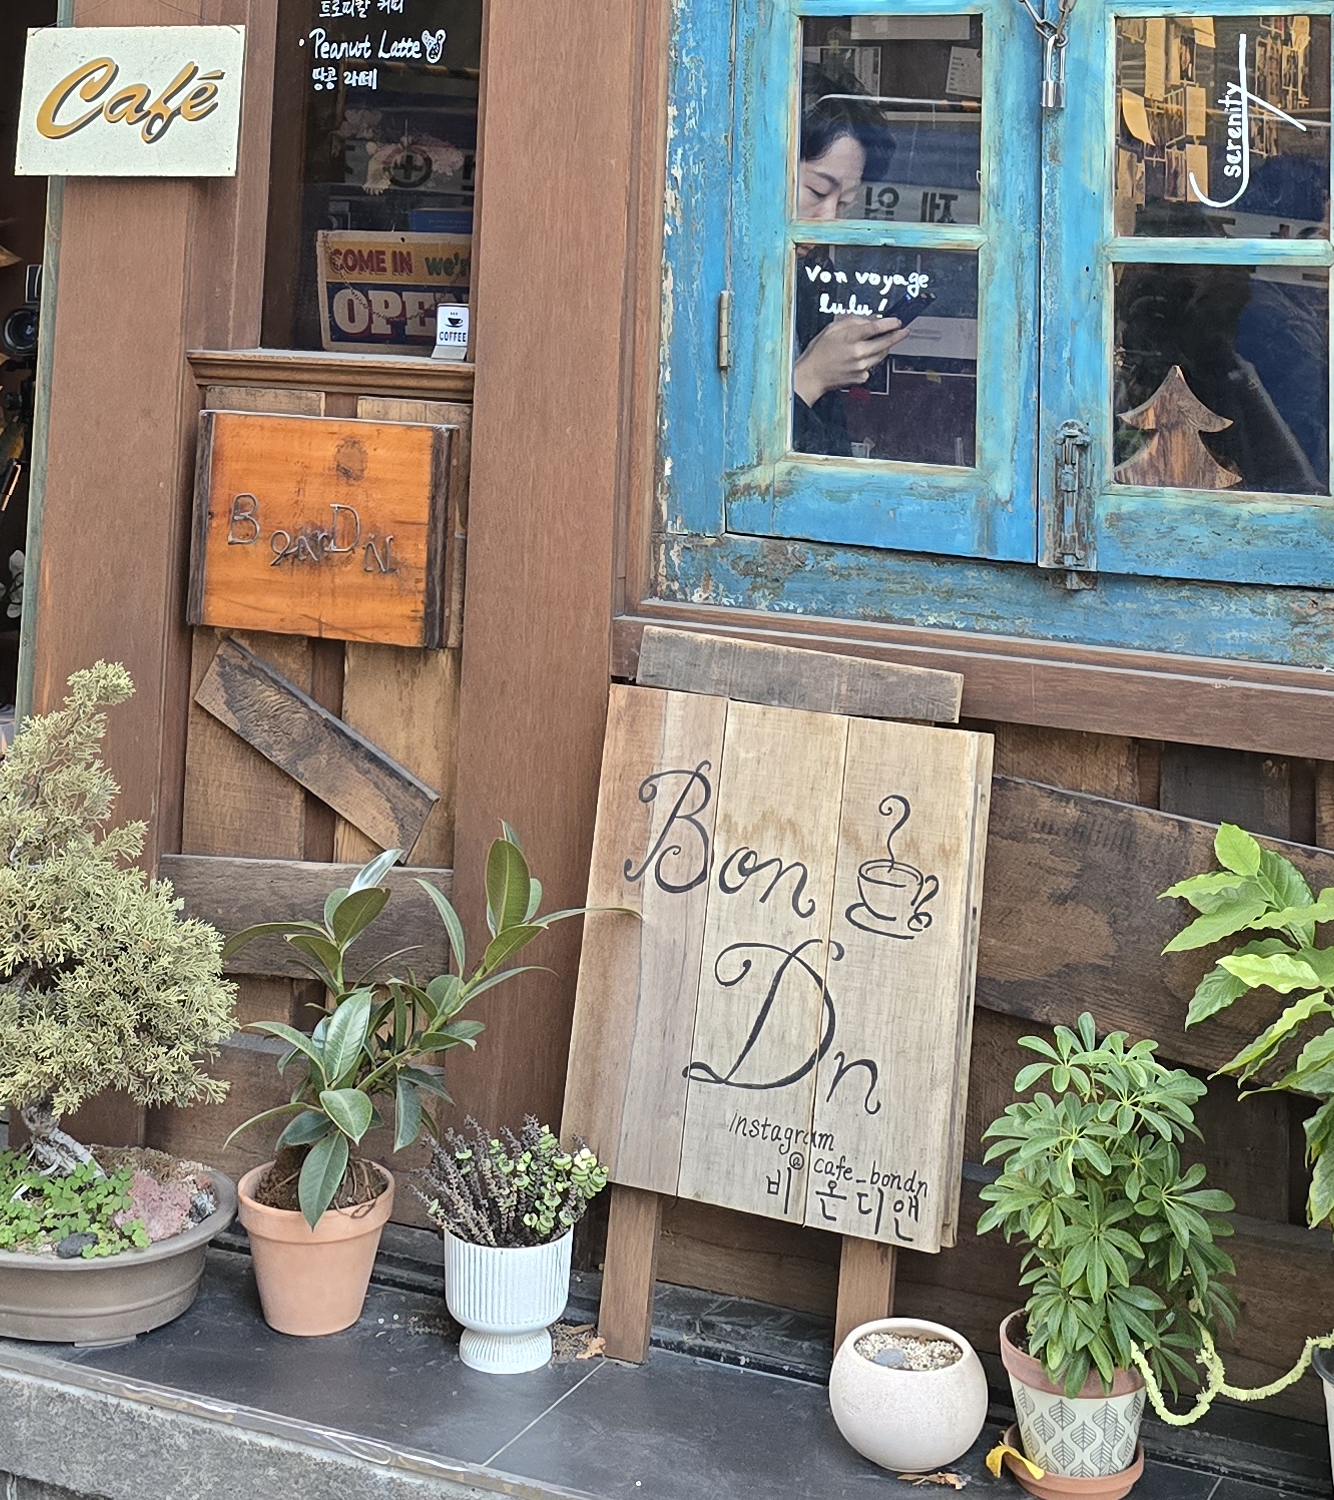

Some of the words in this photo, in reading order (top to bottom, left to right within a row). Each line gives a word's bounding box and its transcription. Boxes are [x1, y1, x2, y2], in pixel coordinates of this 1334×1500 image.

[309, 28, 372, 60] Peanut
[378, 30, 422, 59] Latte
[312, 67, 338, 91] 땅콩
[36, 57, 226, 144] Café
[332, 248, 387, 276] COME
[392, 251, 414, 275] IN
[805, 265, 848, 283] Von
[855, 272, 930, 298] voyage
[333, 289, 470, 336] OPE
[439, 331, 467, 342] COFFEE
[624, 760, 816, 918] Bon
[682, 938, 881, 1114] Dn
